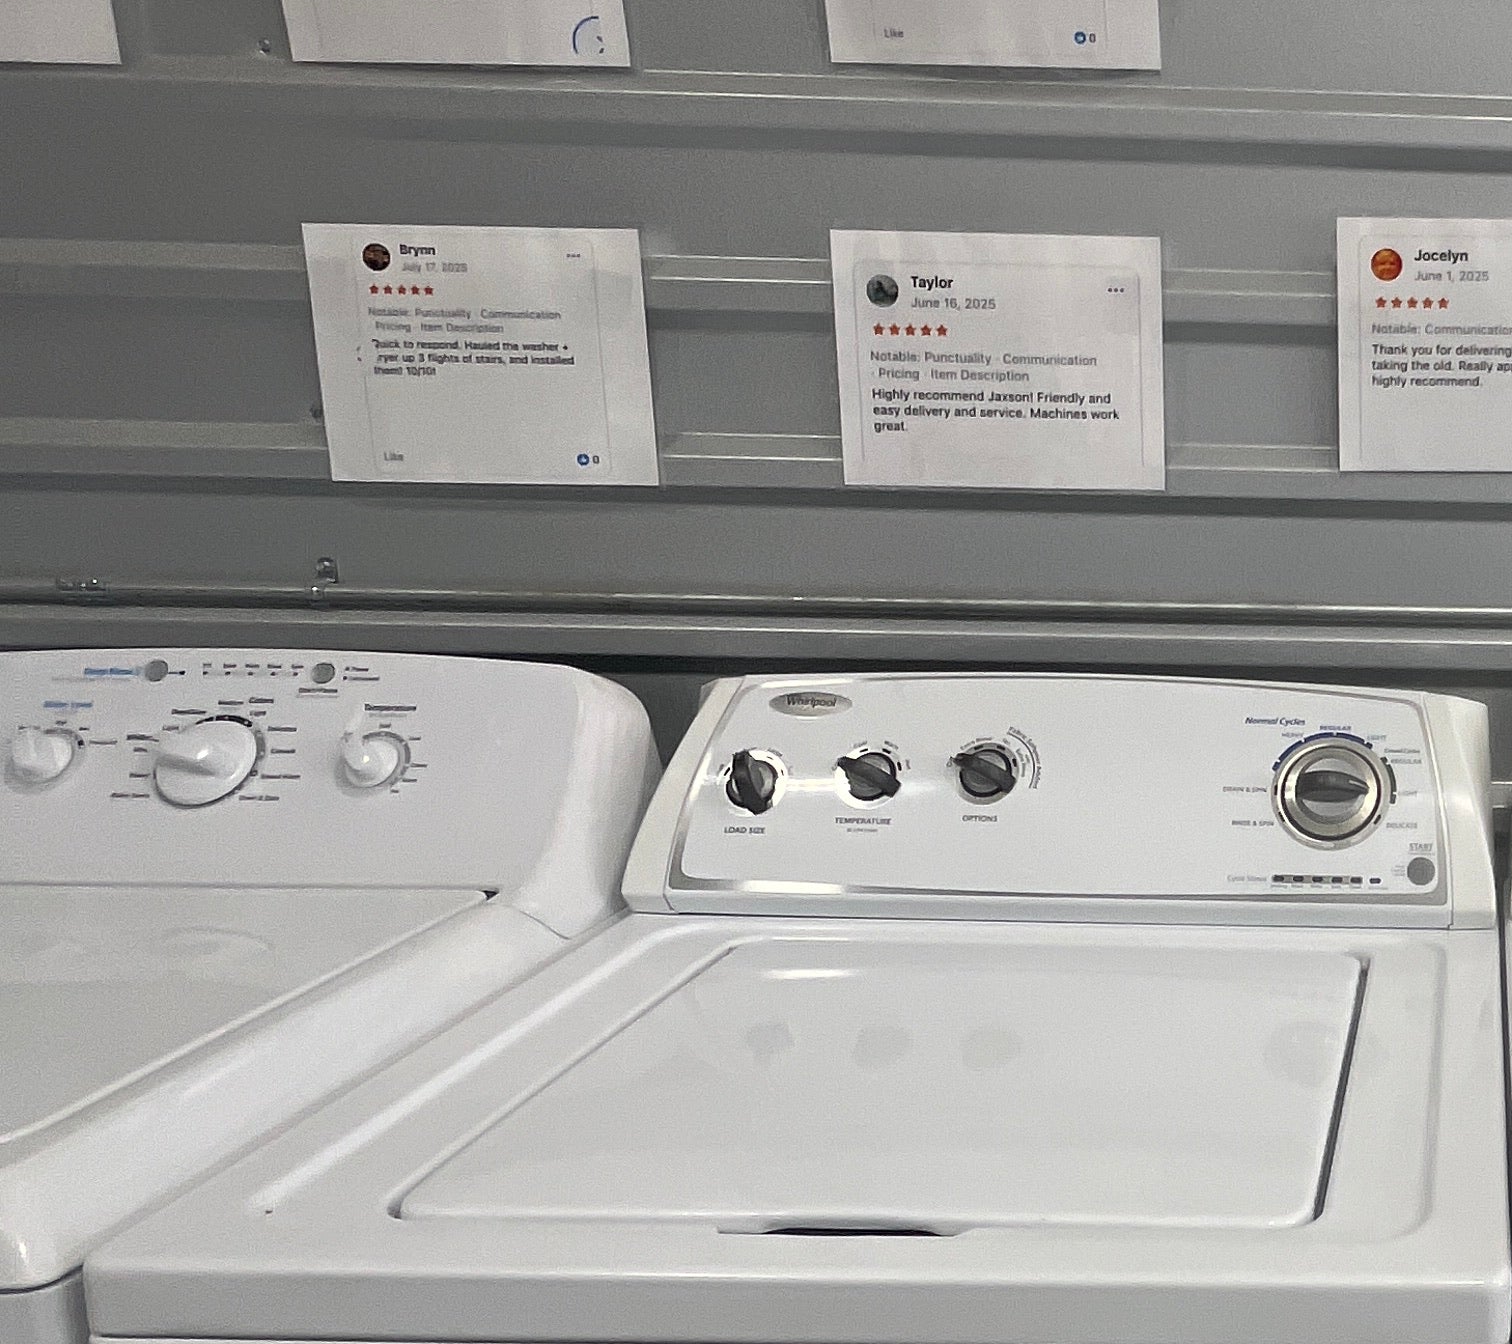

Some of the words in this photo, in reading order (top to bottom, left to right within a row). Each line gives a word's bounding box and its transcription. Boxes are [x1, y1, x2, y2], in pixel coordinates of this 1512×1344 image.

[399, 245, 436, 257] Brynn
[1414, 250, 1468, 264] Jocelyn
[911, 276, 953, 291] Taylor
[1414, 271, 1442, 281] June
[1447, 272, 1455, 283] 1,
[1459, 271, 1489, 281] 2025
[911, 298, 940, 309] June
[965, 298, 996, 310] 2025
[1372, 324, 1420, 335] Notable:
[403, 340, 414, 350] to
[502, 342, 518, 351] the
[522, 343, 559, 352] washer
[1372, 344, 1407, 355] Thank
[1411, 345, 1432, 357] you
[1436, 344, 1451, 355] for
[378, 354, 399, 364] ryer
[403, 355, 415, 364] up
[428, 355, 459, 365] flights
[462, 355, 472, 364] of
[475, 355, 506, 366] stairs,
[509, 356, 528, 365] and
[531, 356, 574, 366] installed
[870, 351, 920, 362] Notable:
[924, 352, 992, 365] Punctuality
[1003, 354, 1097, 366] Communication
[1372, 360, 1407, 373] taking
[1411, 360, 1430, 371] the
[1458, 361, 1493, 373] Really
[878, 368, 920, 381] Pricing
[930, 370, 957, 380] Item
[961, 370, 1030, 383] Description
[1372, 375, 1407, 388] highly
[872, 389, 910, 402] Highly
[913, 390, 985, 402] recommend
[988, 391, 1033, 402] Jaxson!
[1037, 392, 1085, 405] Friendly
[1089, 394, 1111, 404] and
[873, 406, 900, 417] easy
[904, 406, 950, 419] delivery
[954, 407, 976, 418] and
[980, 408, 1026, 418] service.
[1030, 409, 1087, 419] Machines
[1091, 410, 1119, 420] work
[874, 421, 908, 433] great.
[786, 695, 837, 708] Whirlpool
